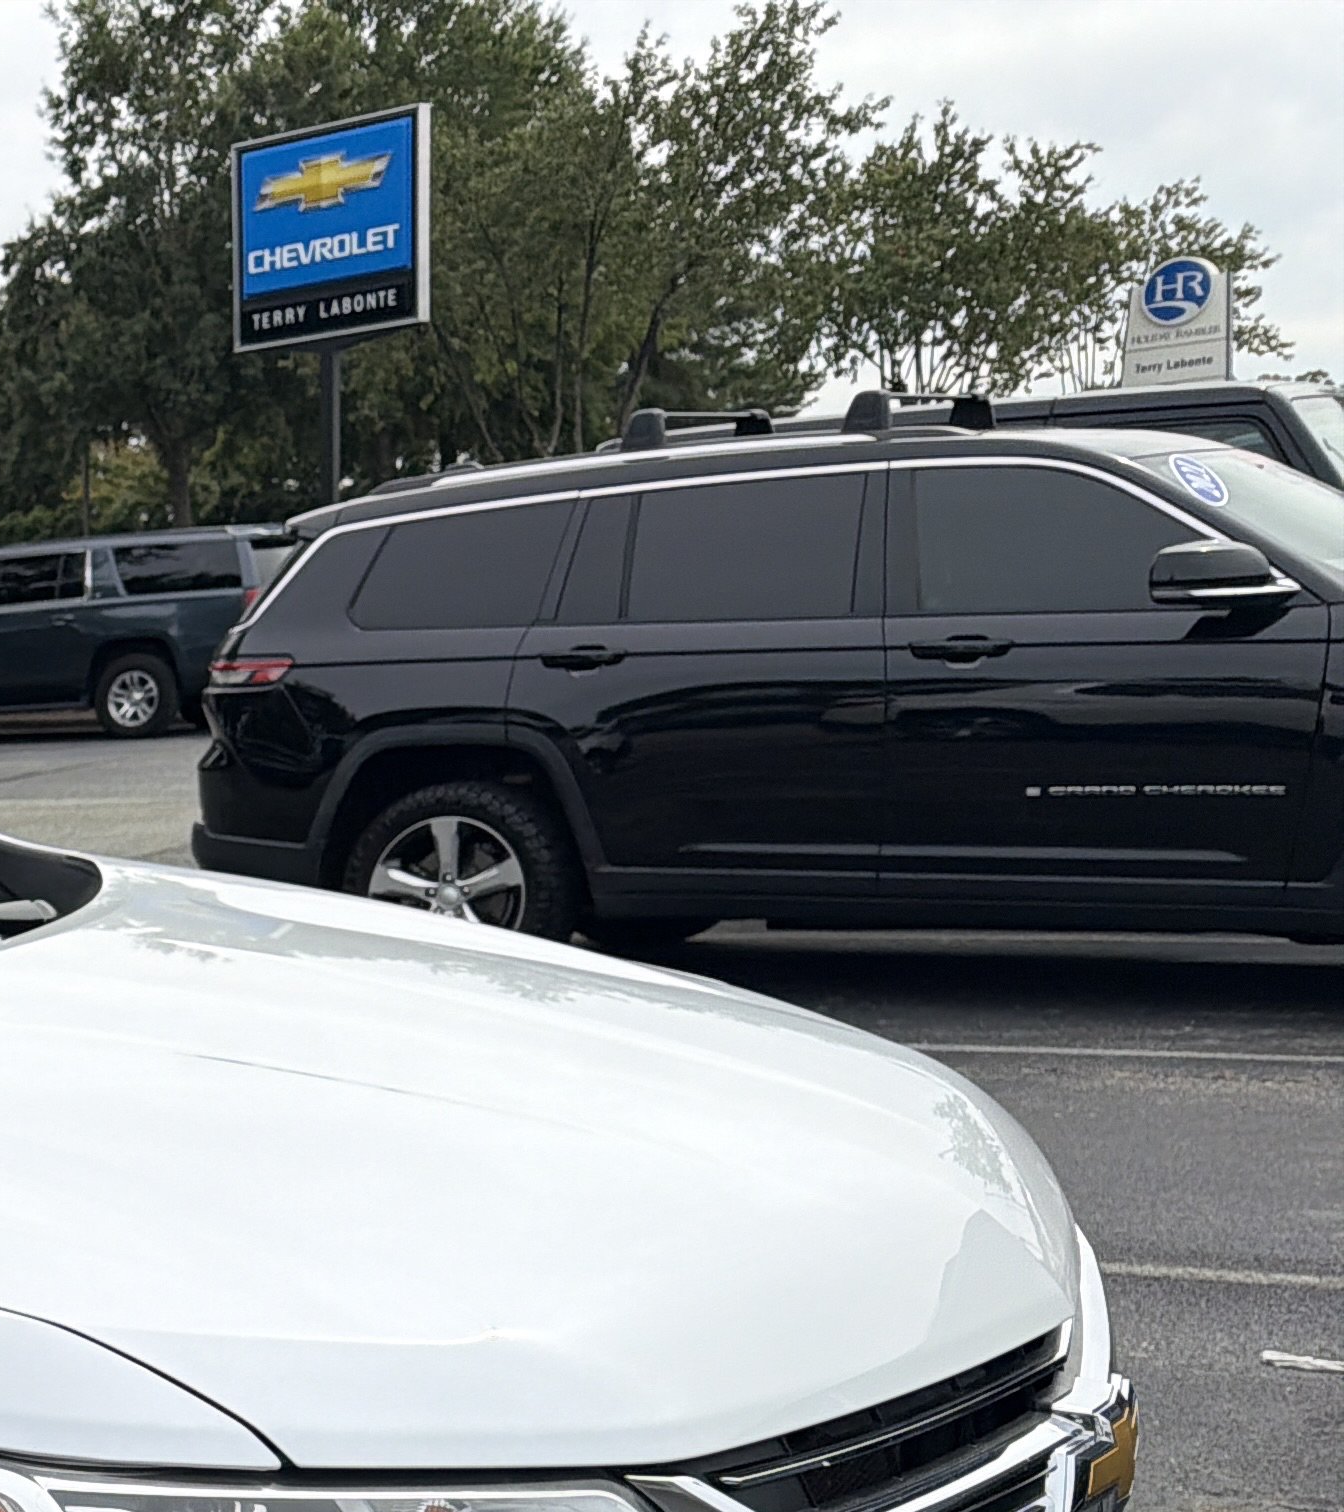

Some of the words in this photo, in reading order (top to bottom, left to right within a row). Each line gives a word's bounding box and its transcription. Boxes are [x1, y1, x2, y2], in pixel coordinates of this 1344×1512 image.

[248, 223, 400, 275] CHEVROLET
[252, 305, 306, 331] TERRY
[319, 288, 398, 319] LABONTE
[1135, 363, 1163, 374] Terry
